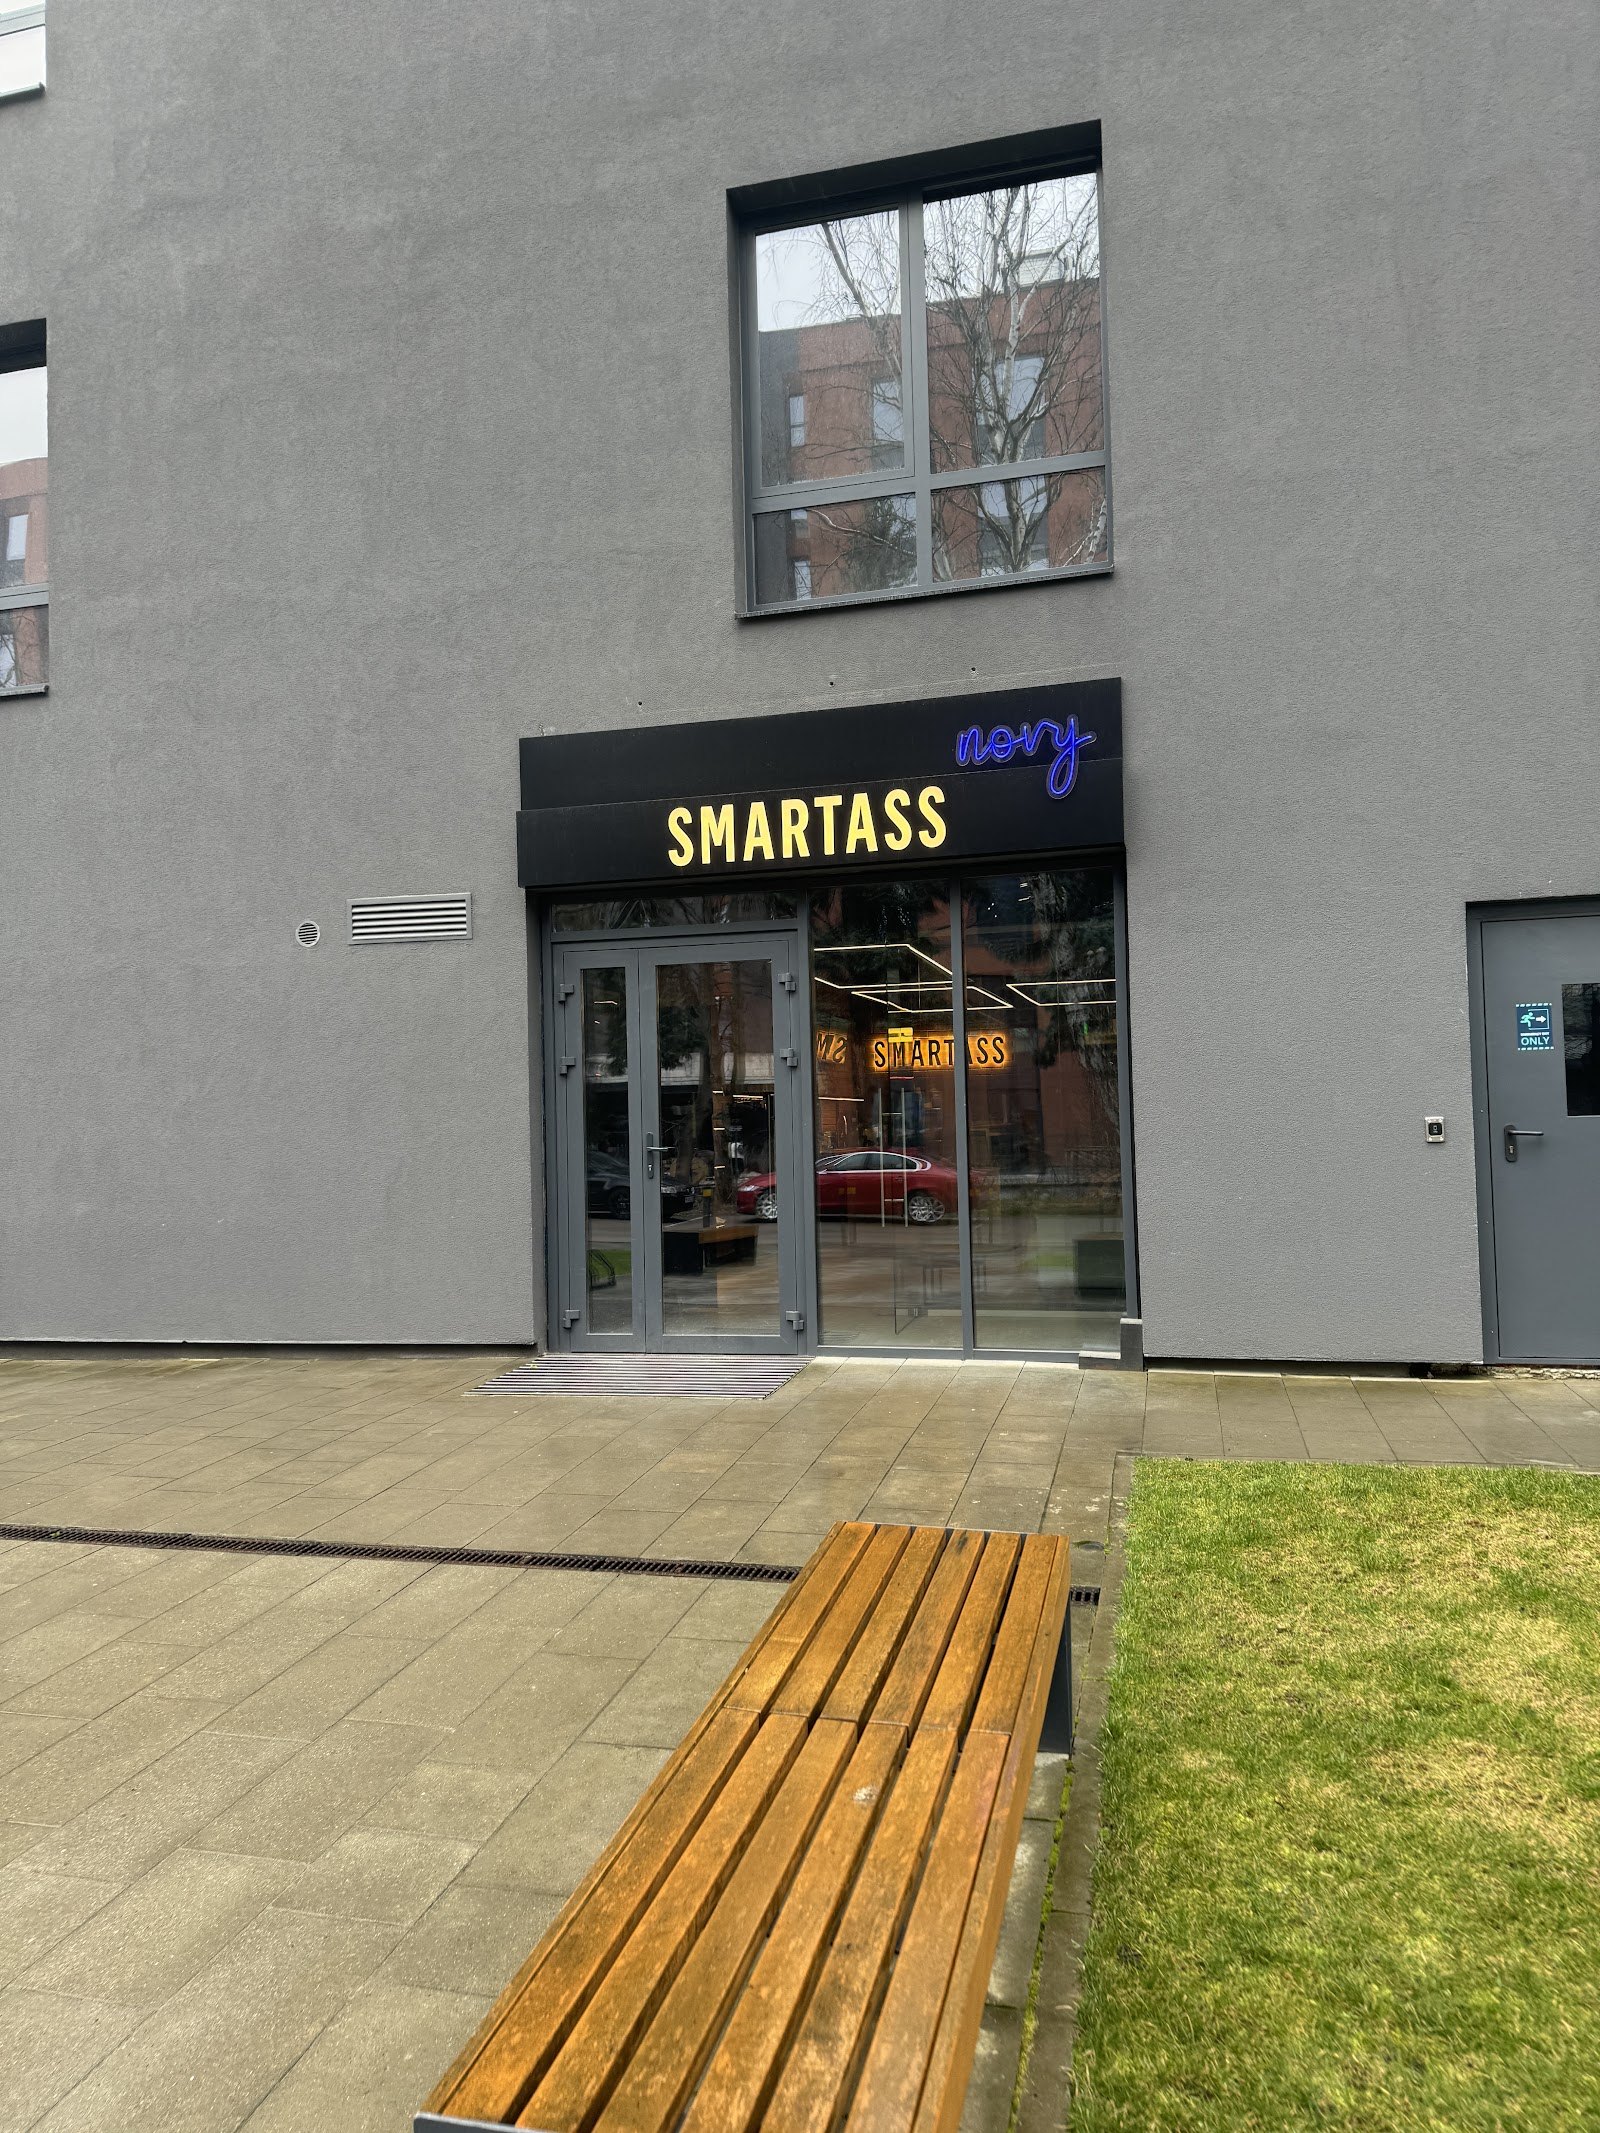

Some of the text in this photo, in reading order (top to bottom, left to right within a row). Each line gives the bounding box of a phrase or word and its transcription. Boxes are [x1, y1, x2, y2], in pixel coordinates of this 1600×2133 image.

[957, 719, 1093, 796] novy
[668, 785, 947, 867] SMARTASS
[1520, 1036, 1550, 1046] ONLY
